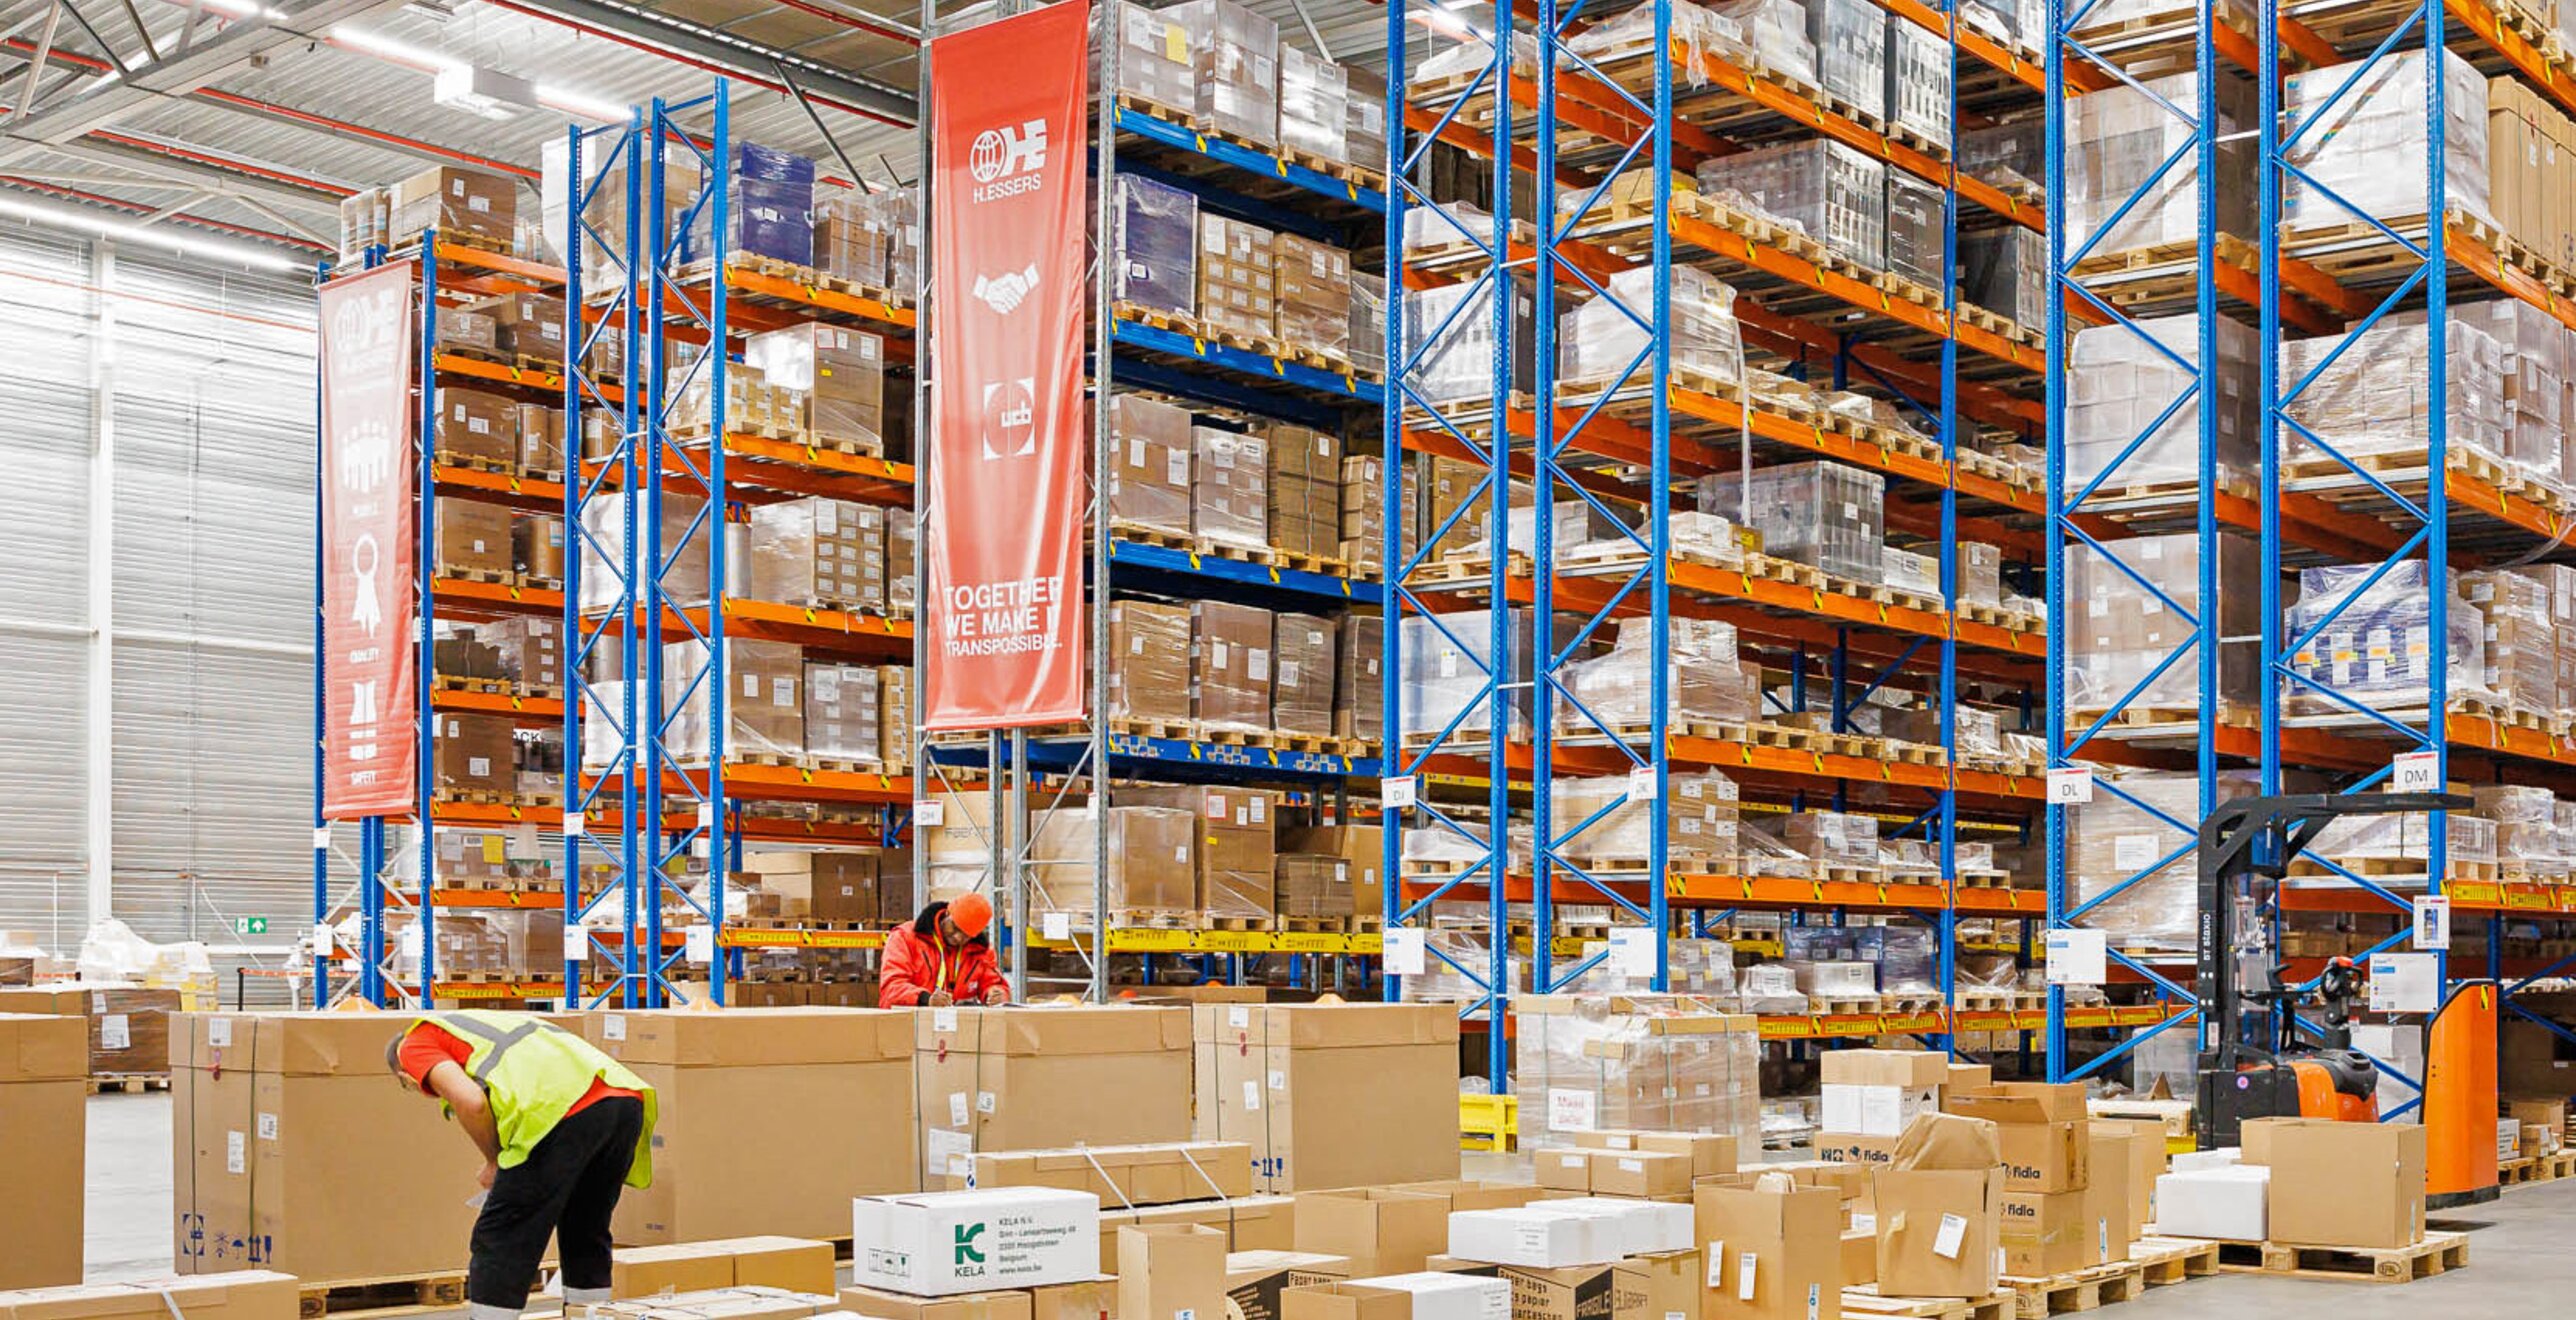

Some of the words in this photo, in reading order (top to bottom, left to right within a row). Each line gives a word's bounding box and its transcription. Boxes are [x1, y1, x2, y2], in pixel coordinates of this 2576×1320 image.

[973, 173, 1042, 205] H.ESSERS
[945, 613, 975, 639] WE
[982, 606, 1039, 636] MAKE
[2405, 769, 2428, 784] DM
[2062, 784, 2078, 796] DL
[955, 1266, 986, 1278] KELA
